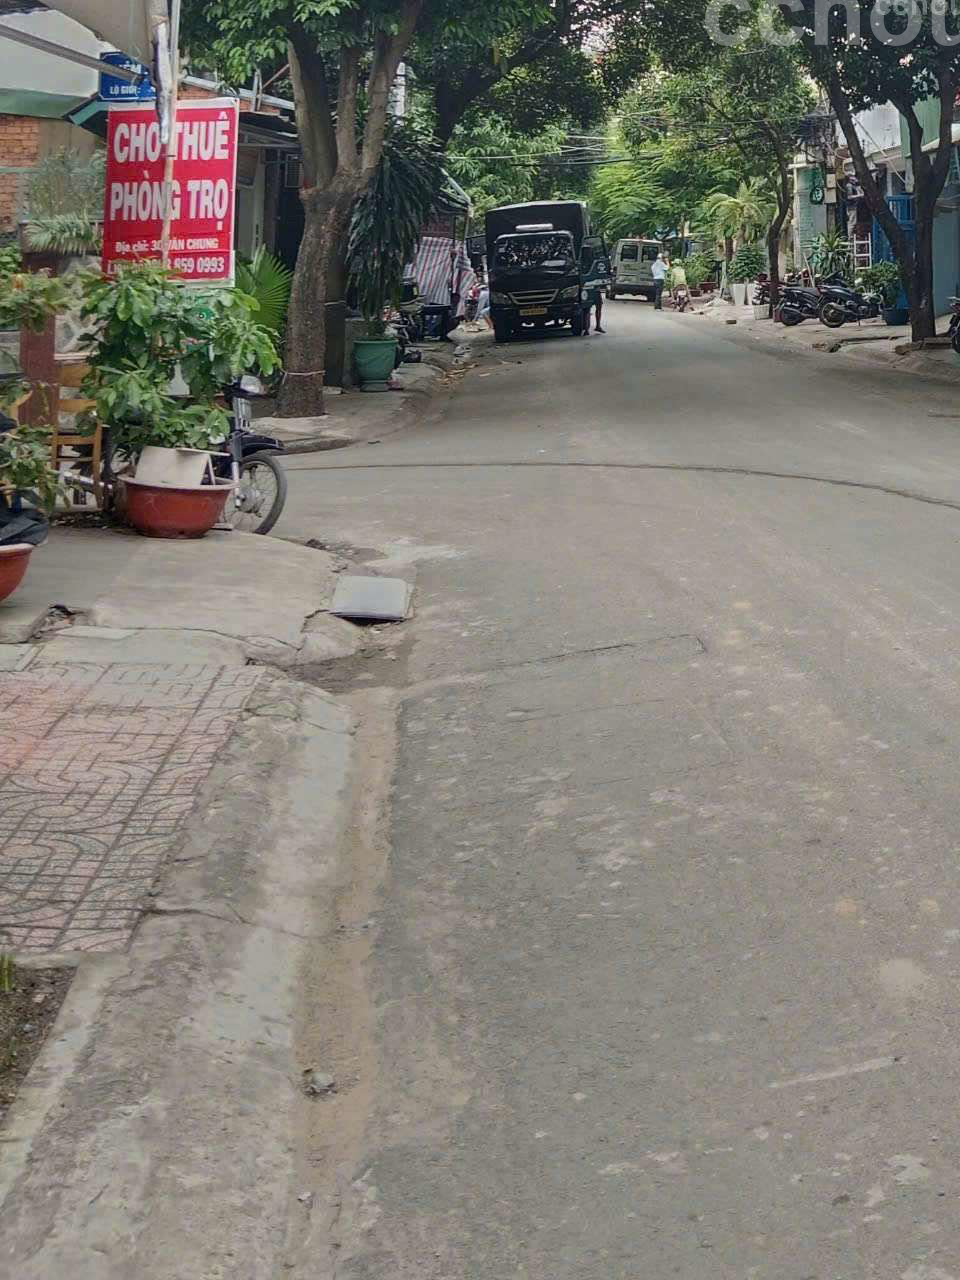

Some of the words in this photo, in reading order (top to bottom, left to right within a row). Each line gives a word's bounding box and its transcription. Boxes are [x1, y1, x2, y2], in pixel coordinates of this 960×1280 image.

[114, 122, 162, 163] CHO
[187, 178, 229, 231] TRỌ
[186, 238, 219, 250] CHUNG
